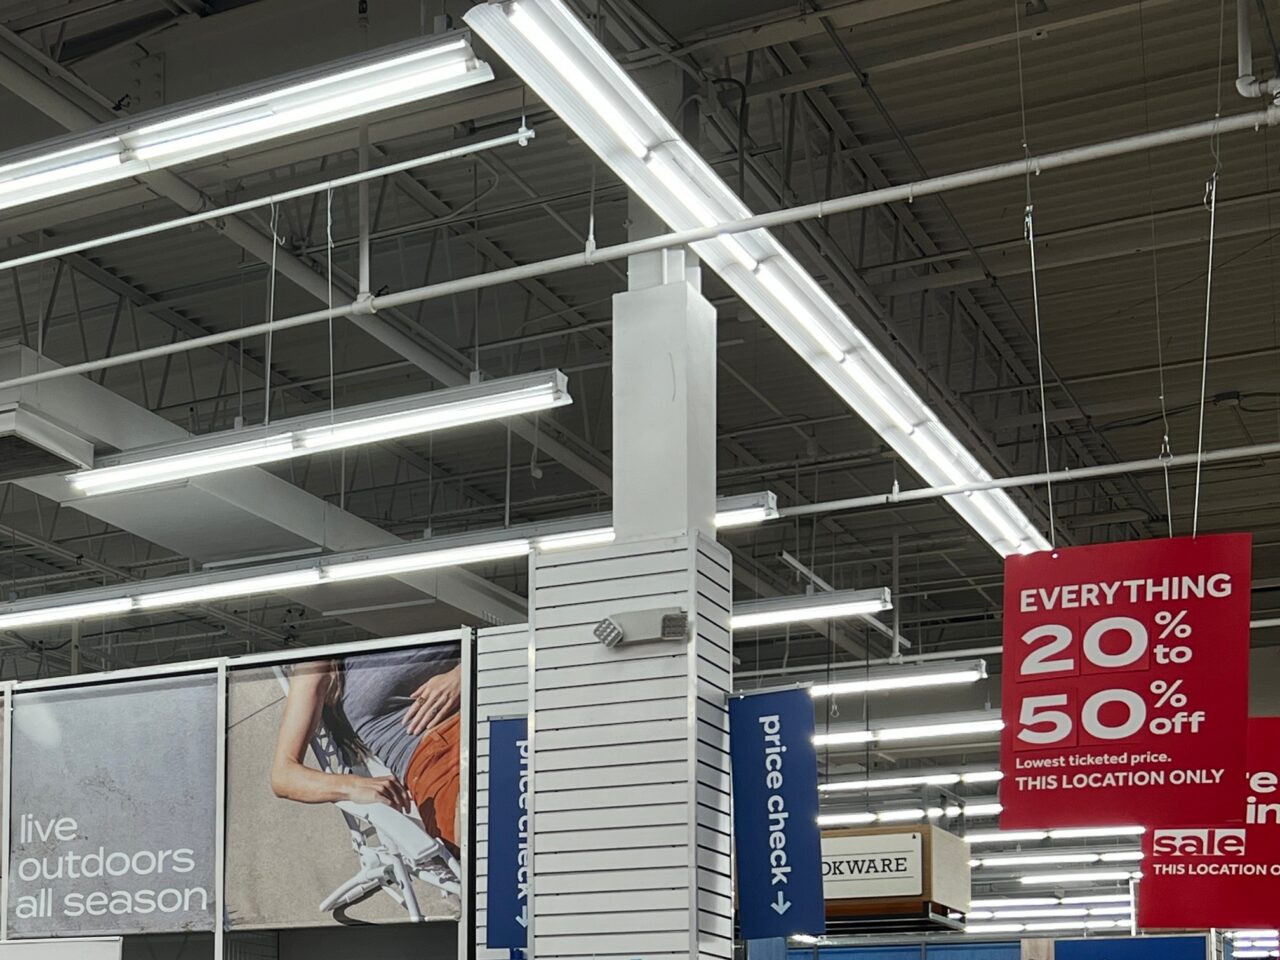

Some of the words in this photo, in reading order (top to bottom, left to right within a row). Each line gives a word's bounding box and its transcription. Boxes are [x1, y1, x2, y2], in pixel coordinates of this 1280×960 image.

[1020, 573, 1231, 613] EVERYTHING
[1020, 610, 1192, 675] 20%
[1153, 644, 1192, 664] to
[1017, 680, 1187, 744] 50%
[1149, 711, 1205, 735] off
[758, 714, 787, 790] price
[1016, 755, 1065, 769] Lowest
[1069, 752, 1127, 765] ticketed
[1131, 751, 1171, 766] price.
[1015, 776, 1058, 790] THIS
[1062, 772, 1165, 788] LOCATION
[1169, 769, 1224, 784] ONLY
[20, 814, 77, 843] live
[767, 793, 792, 884] check
[1153, 829, 1245, 856] sale
[19, 845, 195, 881] outdoors
[1153, 864, 1184, 875] THIS
[1188, 864, 1267, 875] LOCATION
[15, 889, 52, 918] all
[63, 884, 207, 916] season
